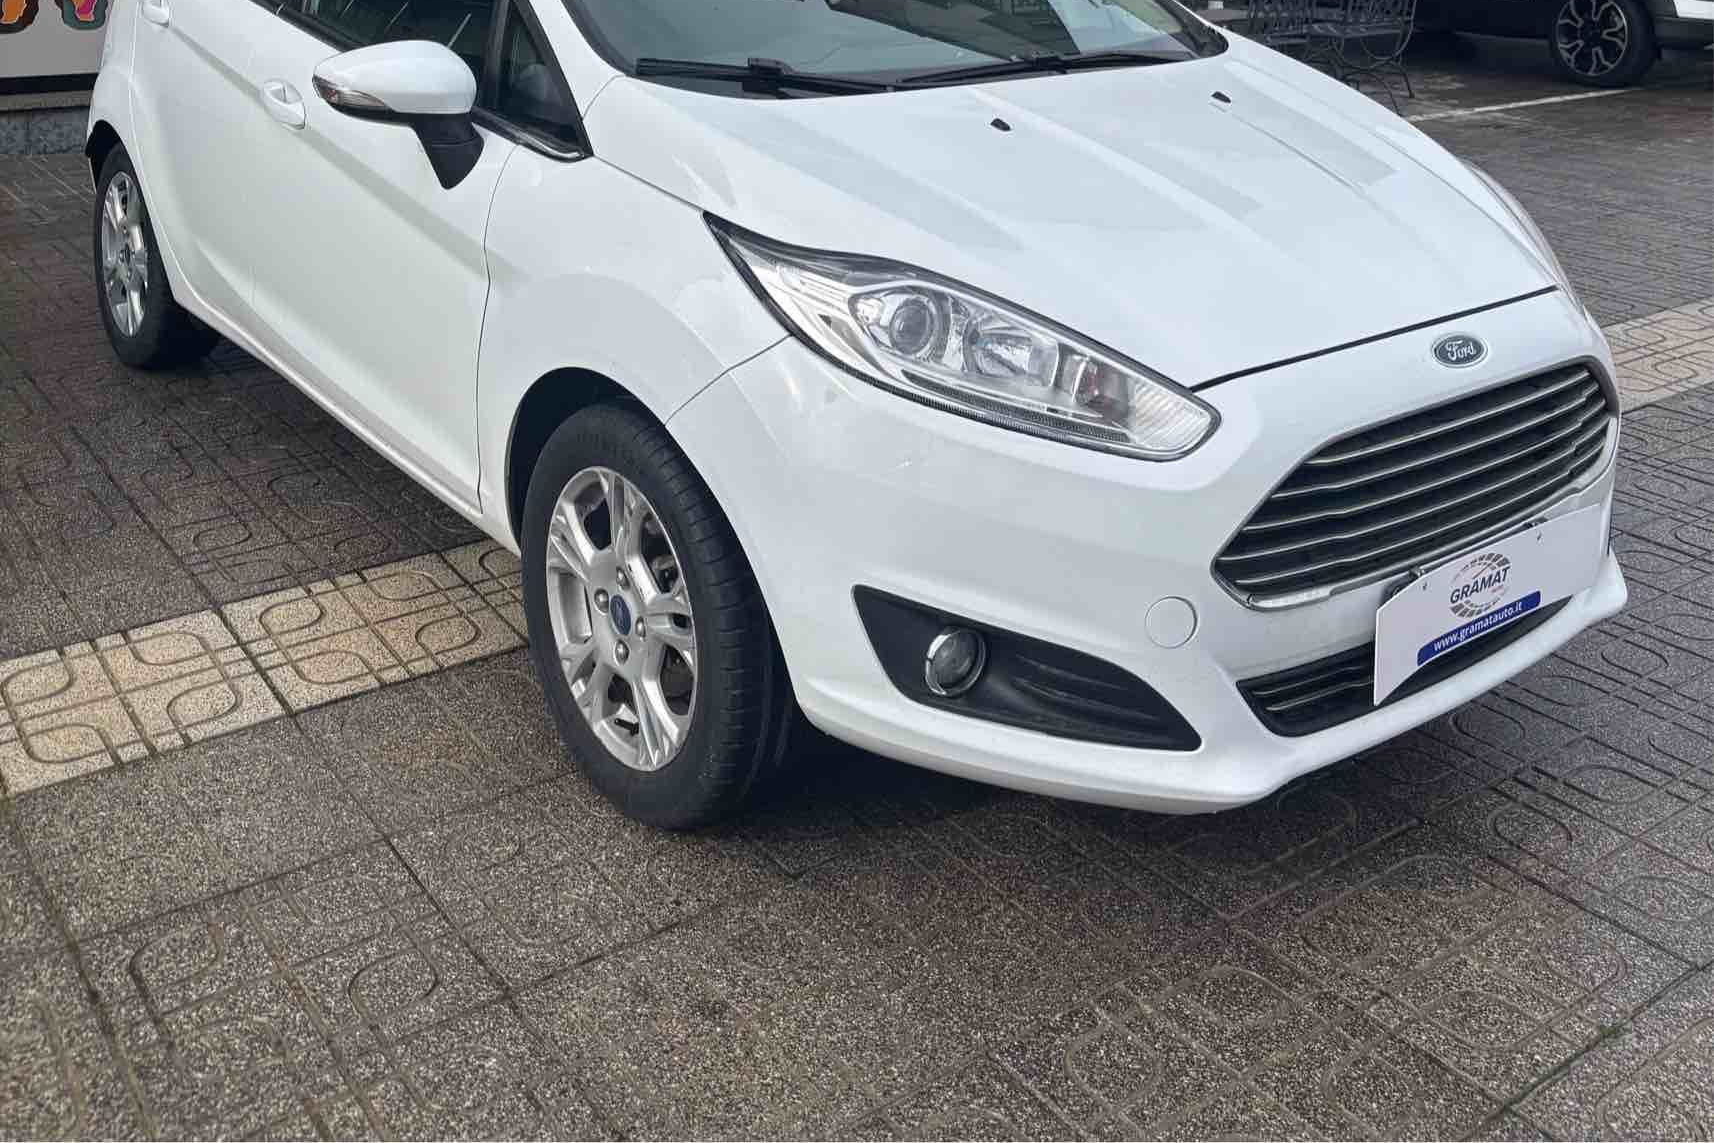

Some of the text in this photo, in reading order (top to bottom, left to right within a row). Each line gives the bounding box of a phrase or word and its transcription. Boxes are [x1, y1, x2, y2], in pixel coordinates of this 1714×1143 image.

[1445, 339, 1477, 361] Ford
[1450, 566, 1512, 605] GRAMAT
[1433, 600, 1524, 652] www.gramatauto.it
